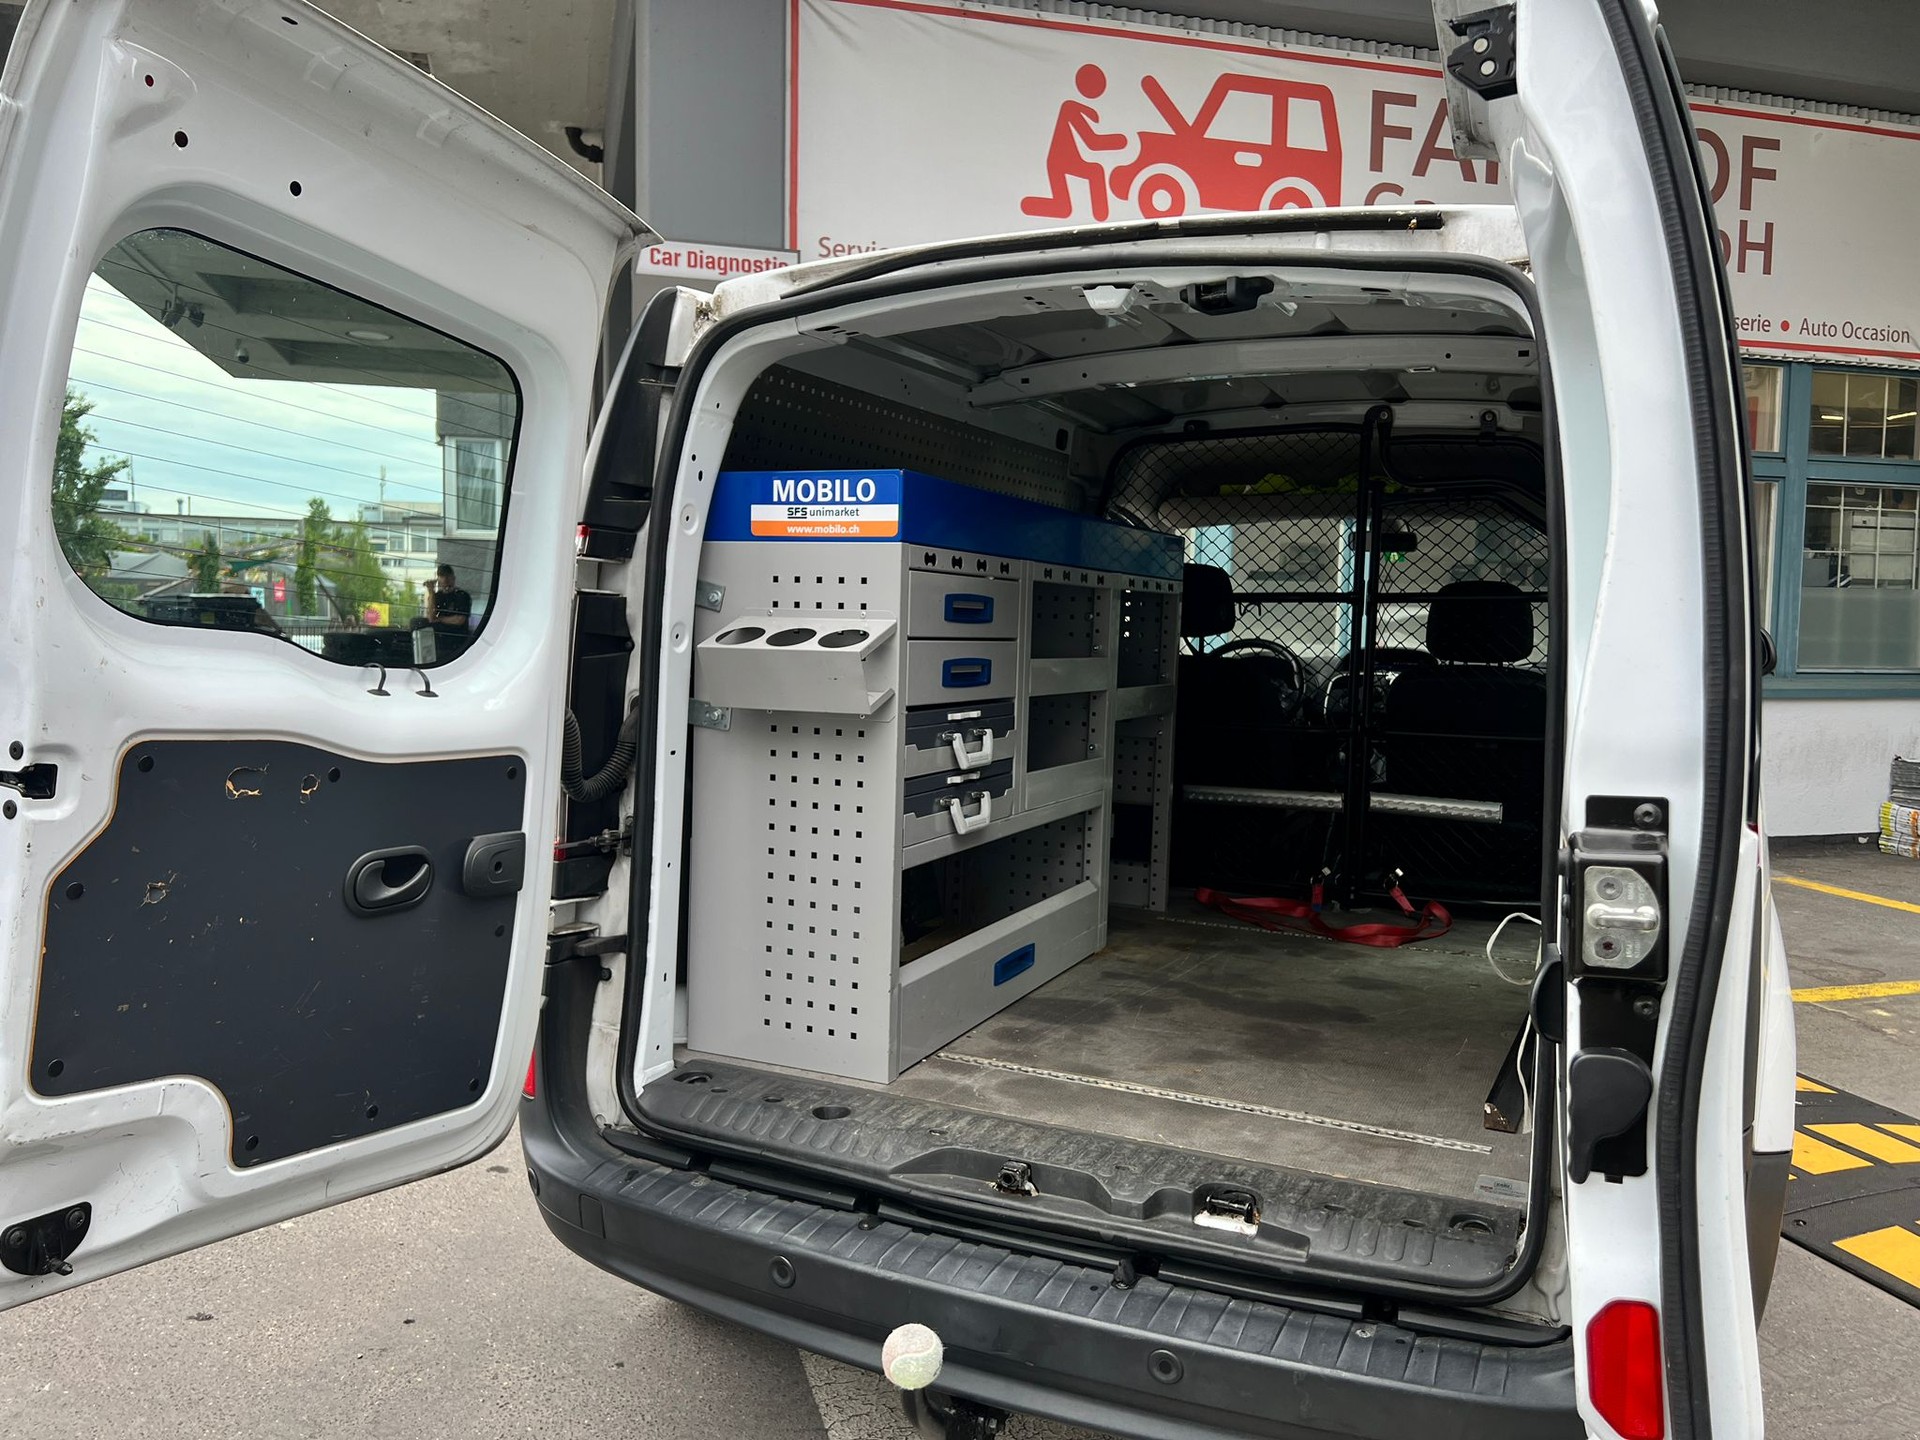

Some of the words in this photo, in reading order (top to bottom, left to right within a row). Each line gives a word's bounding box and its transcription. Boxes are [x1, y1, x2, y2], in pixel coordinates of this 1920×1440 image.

[650, 247, 681, 267] Car
[818, 236, 889, 258] Servi
[1799, 317, 1838, 338] Auto
[1841, 321, 1911, 343] Occasion
[772, 478, 876, 503] MOBILO
[787, 507, 808, 518] SFS
[809, 506, 860, 517] unimarket
[787, 523, 860, 534] www.mobilo.ch
